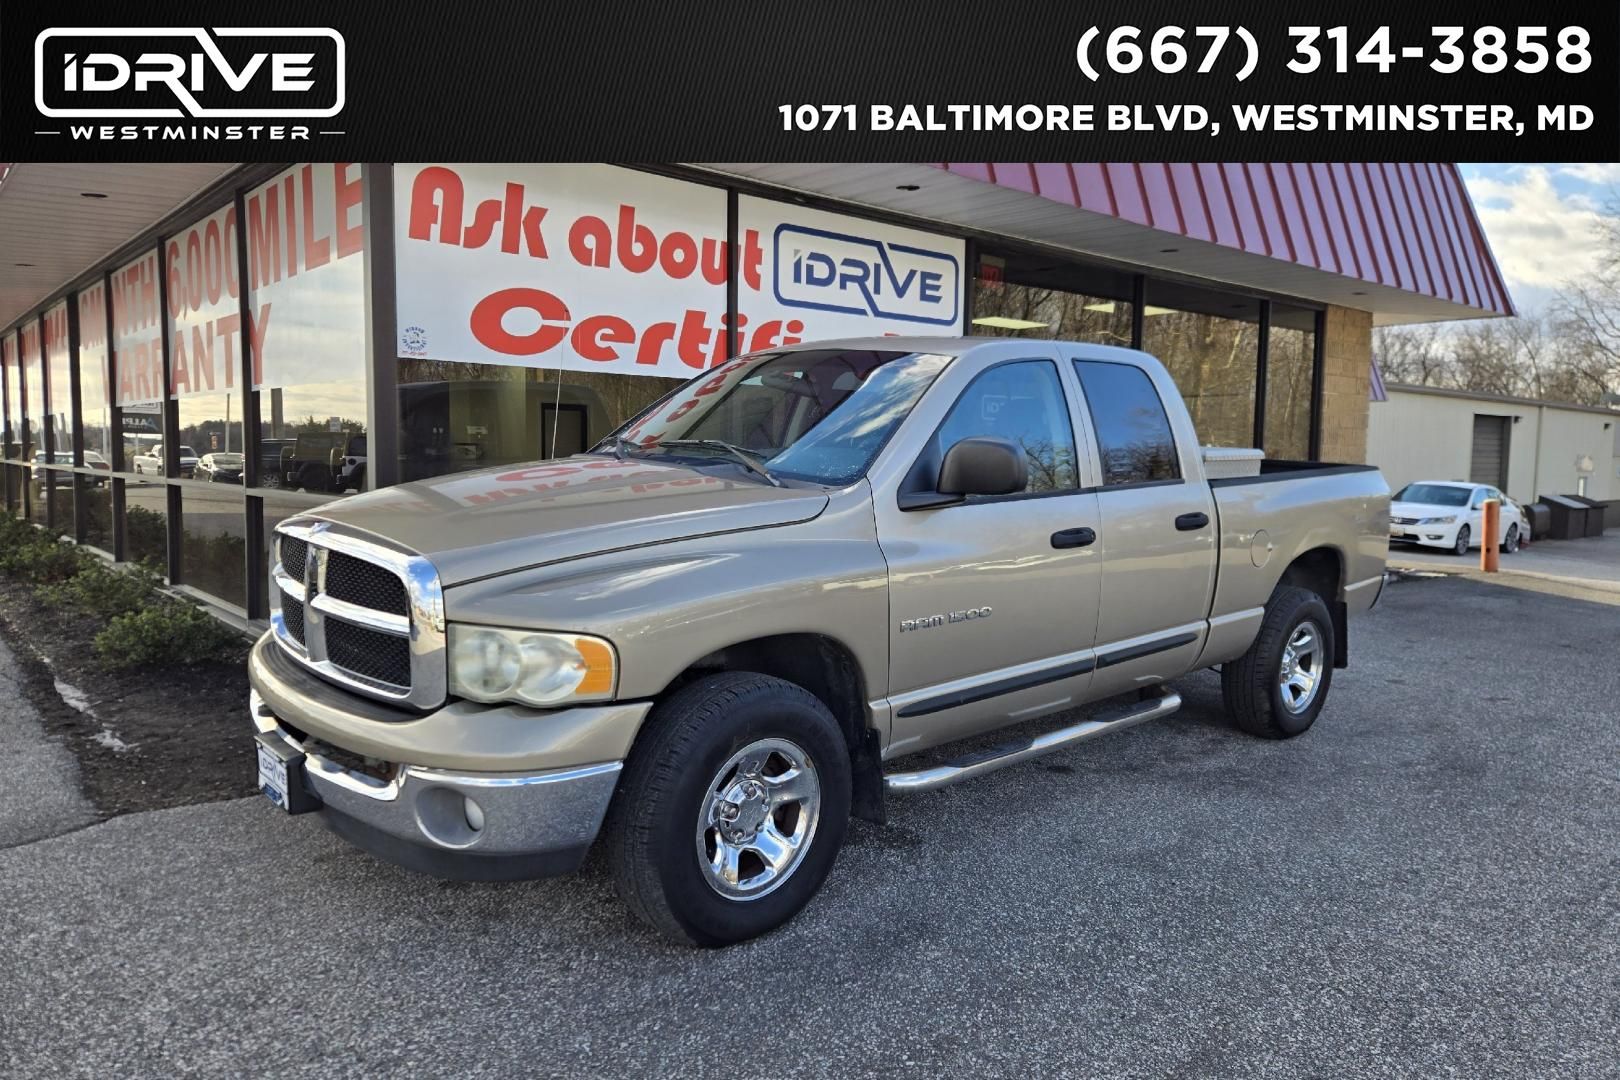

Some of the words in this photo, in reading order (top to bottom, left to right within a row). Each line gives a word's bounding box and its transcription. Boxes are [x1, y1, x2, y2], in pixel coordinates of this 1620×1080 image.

[248, 163, 364, 291] MILE
[408, 166, 548, 259] Ask
[568, 204, 763, 291] about
[948, 606, 993, 624] 1500
